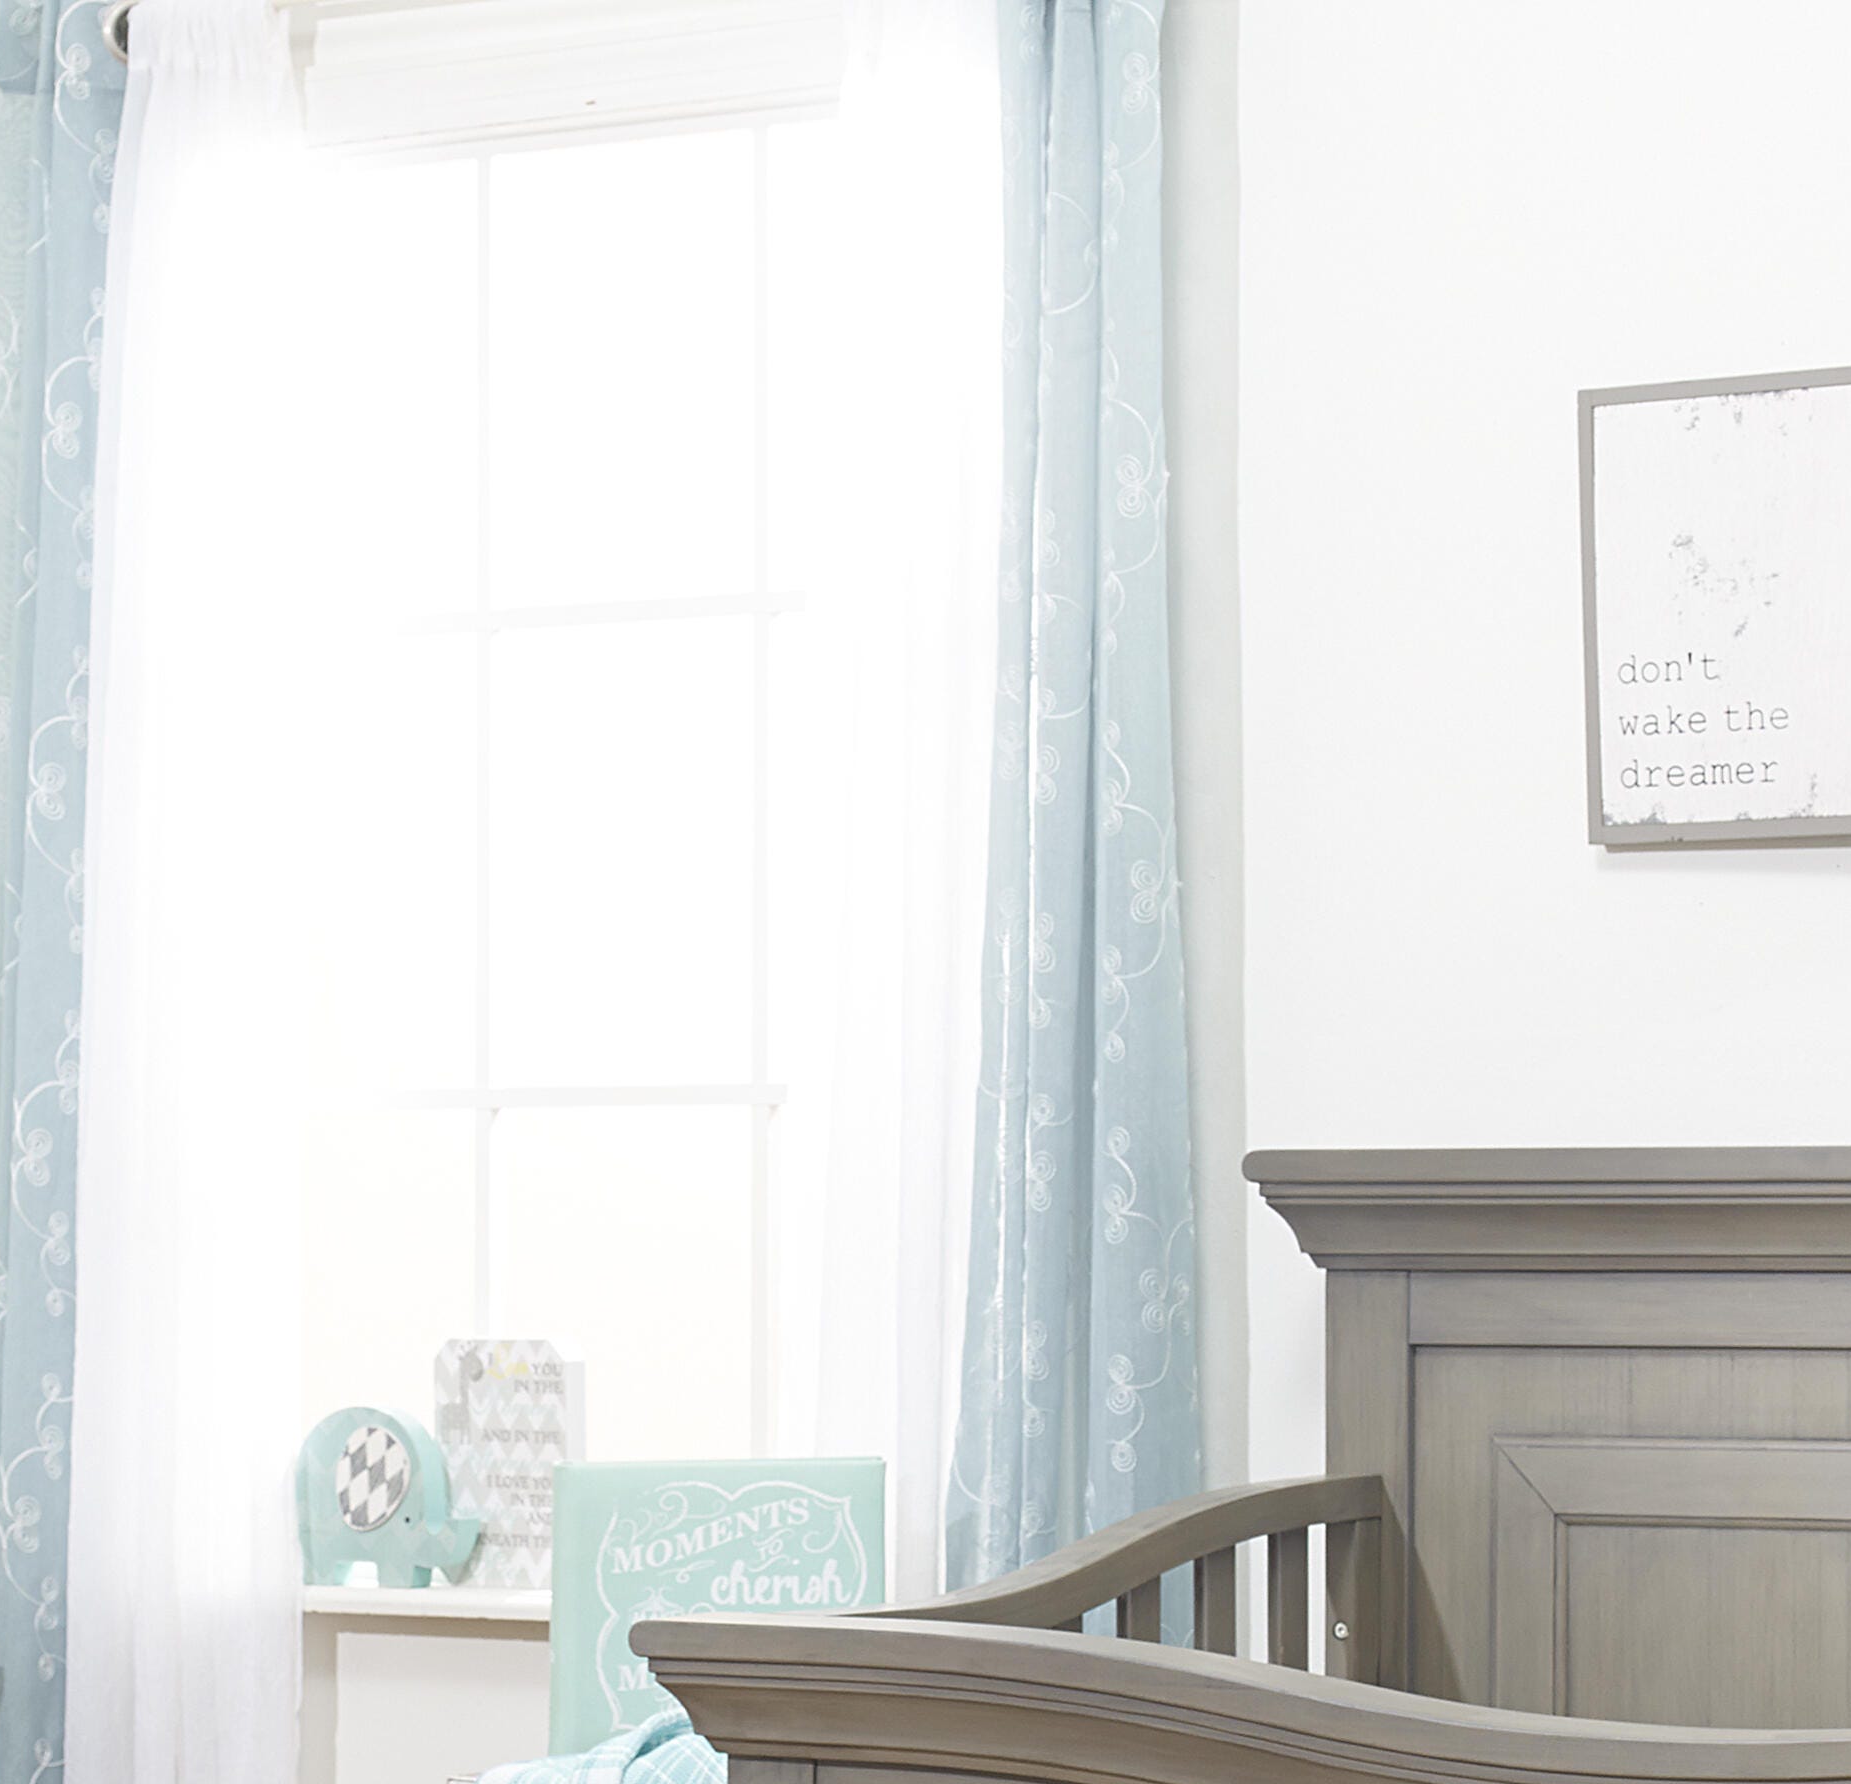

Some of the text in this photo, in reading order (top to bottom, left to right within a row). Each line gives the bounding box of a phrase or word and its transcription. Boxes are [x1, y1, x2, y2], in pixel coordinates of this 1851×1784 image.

[1617, 651, 1721, 685] don't
[1618, 701, 1789, 736] wake the
[1620, 758, 1779, 789] dreamer
[531, 1361, 563, 1377] YOU
[533, 1380, 565, 1394] THE
[480, 1429, 511, 1442] AND
[531, 1430, 562, 1445] THE
[494, 1475, 529, 1489] LOVE
[531, 1477, 551, 1490] YO
[611, 1497, 810, 1574] MOMENTS
[757, 1539, 783, 1562] TO
[709, 1557, 852, 1606] cherish
